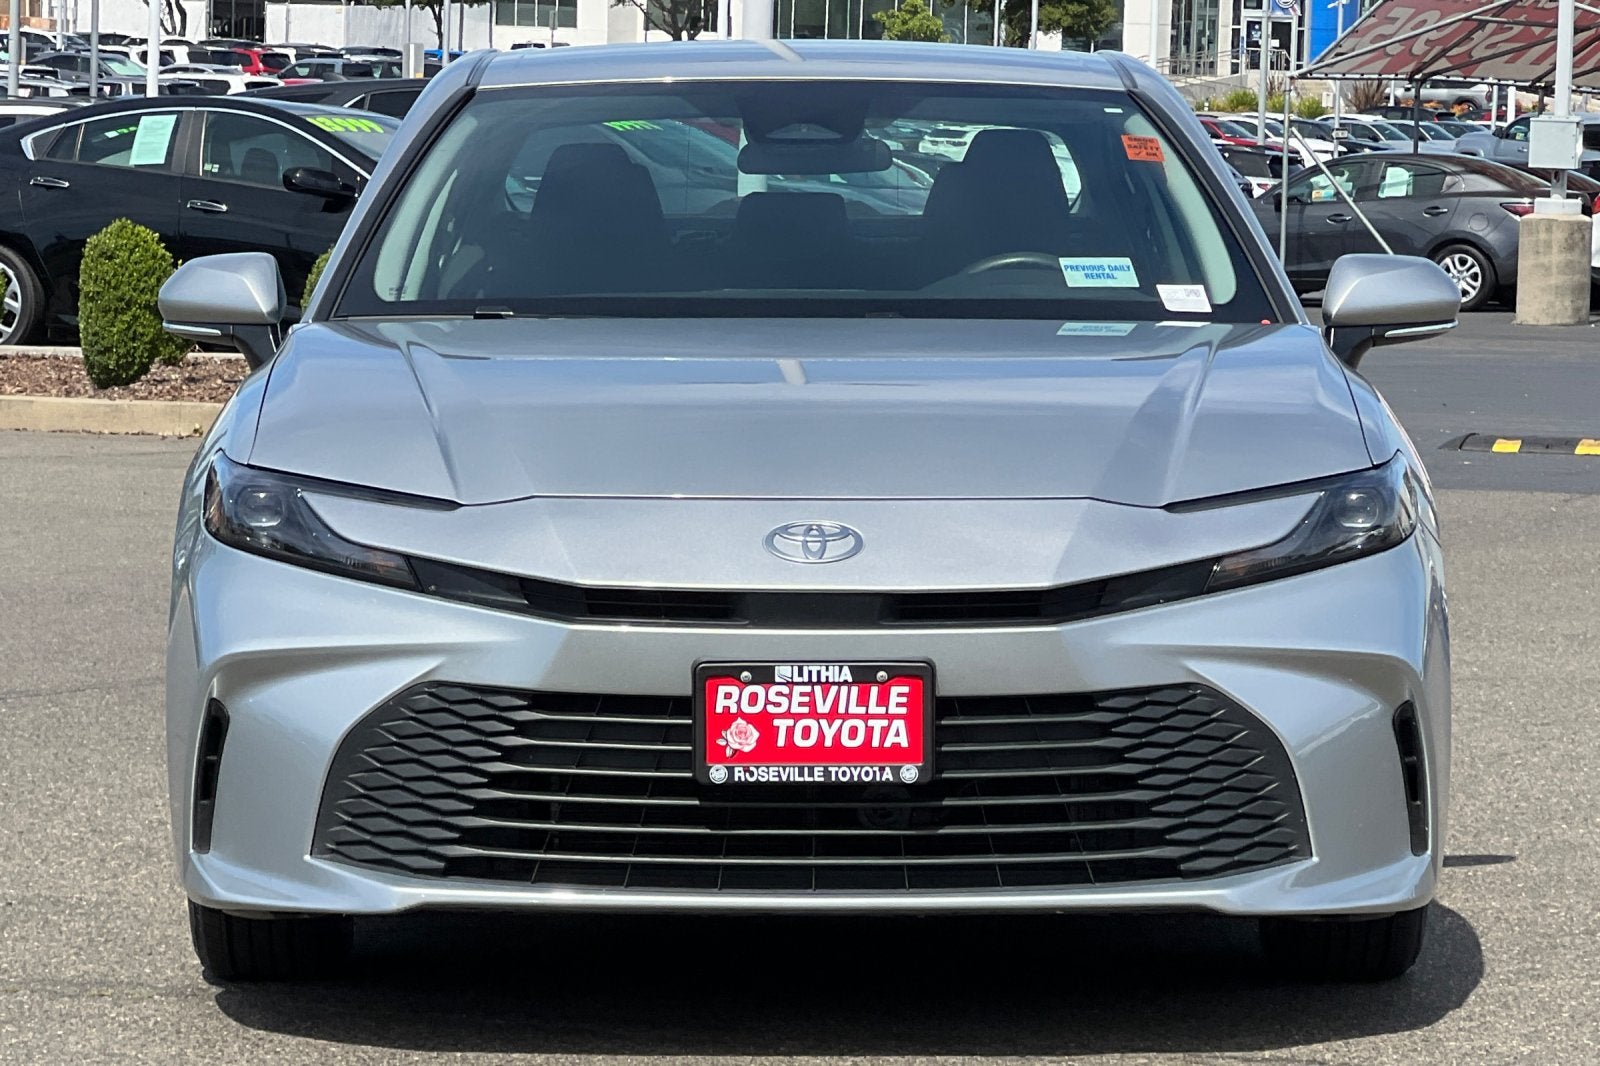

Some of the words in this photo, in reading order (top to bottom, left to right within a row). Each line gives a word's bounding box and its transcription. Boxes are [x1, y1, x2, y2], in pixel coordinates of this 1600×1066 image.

[1064, 264, 1105, 272] PREVIOUS
[1108, 264, 1131, 272] DAILY
[1084, 272, 1117, 280] RENTAL
[793, 666, 853, 682] LITHIA
[714, 684, 910, 714] ROSEVILLE
[773, 718, 909, 748] TOYOTA
[734, 766, 825, 782] ROSEVILLE
[828, 766, 893, 782] TOYOTA
